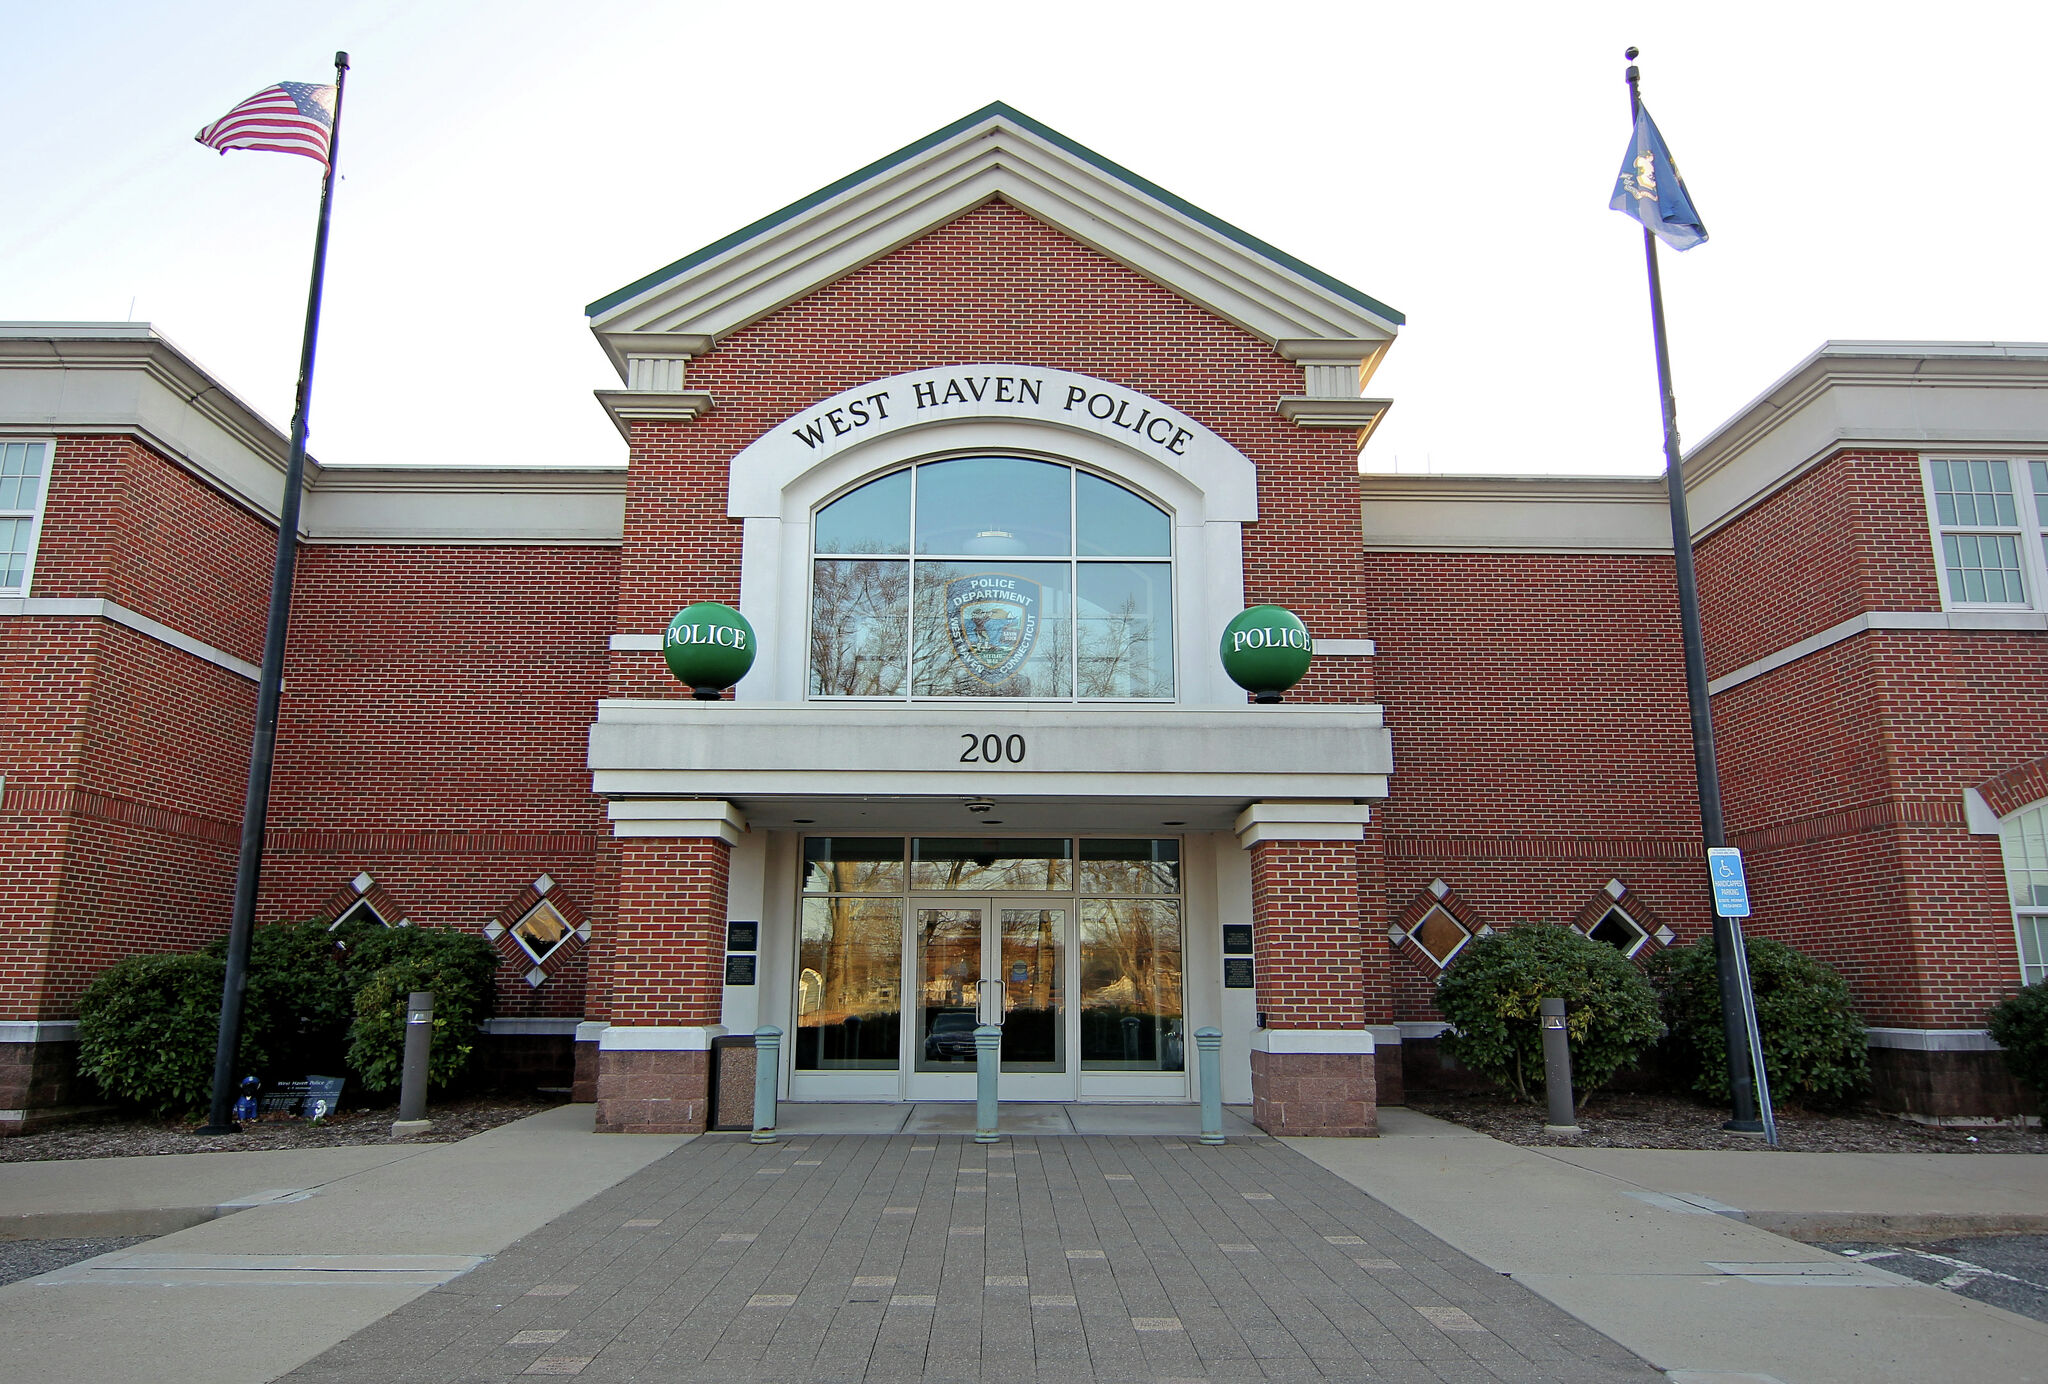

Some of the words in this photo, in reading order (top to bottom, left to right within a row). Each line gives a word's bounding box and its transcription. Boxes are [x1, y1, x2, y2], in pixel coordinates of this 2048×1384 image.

[792, 391, 890, 449] WEST
[912, 377, 1043, 408] HAVEN
[1064, 385, 1193, 456] POLICE
[953, 589, 1033, 606] DEPARTMENT
[971, 578, 1015, 589] POLICE
[667, 624, 746, 650] POLICE
[950, 617, 964, 643] WEST
[958, 645, 985, 673] HAVEN
[1000, 614, 1035, 674] CONNECTICUT
[1231, 627, 1311, 652] POLICE
[960, 733, 1026, 763] 200
